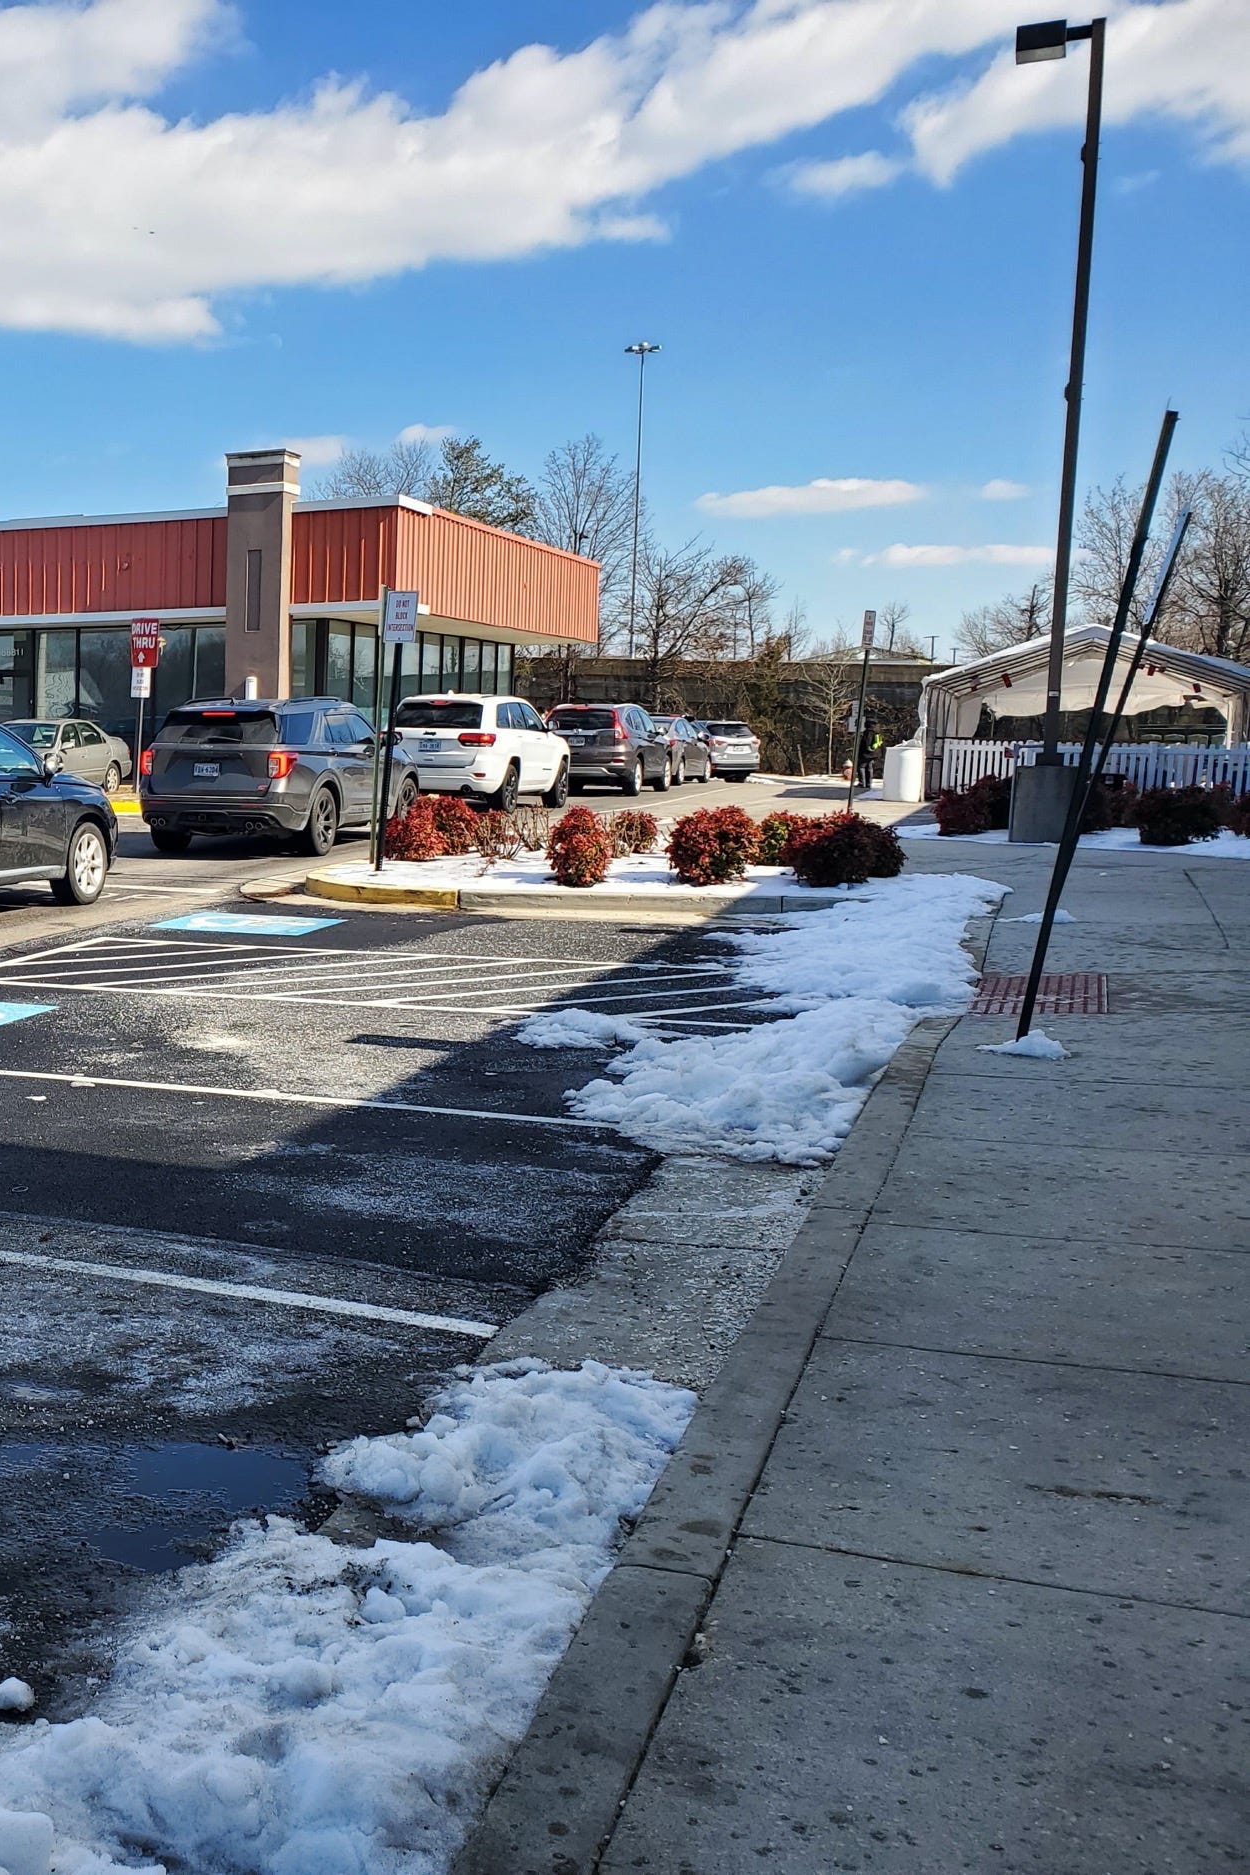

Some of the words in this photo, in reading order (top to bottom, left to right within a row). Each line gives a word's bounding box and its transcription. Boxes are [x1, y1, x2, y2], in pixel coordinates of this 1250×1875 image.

[395, 600, 402, 608] DO
[131, 622, 158, 635] DRIVE
[132, 636, 156, 649] THRU
